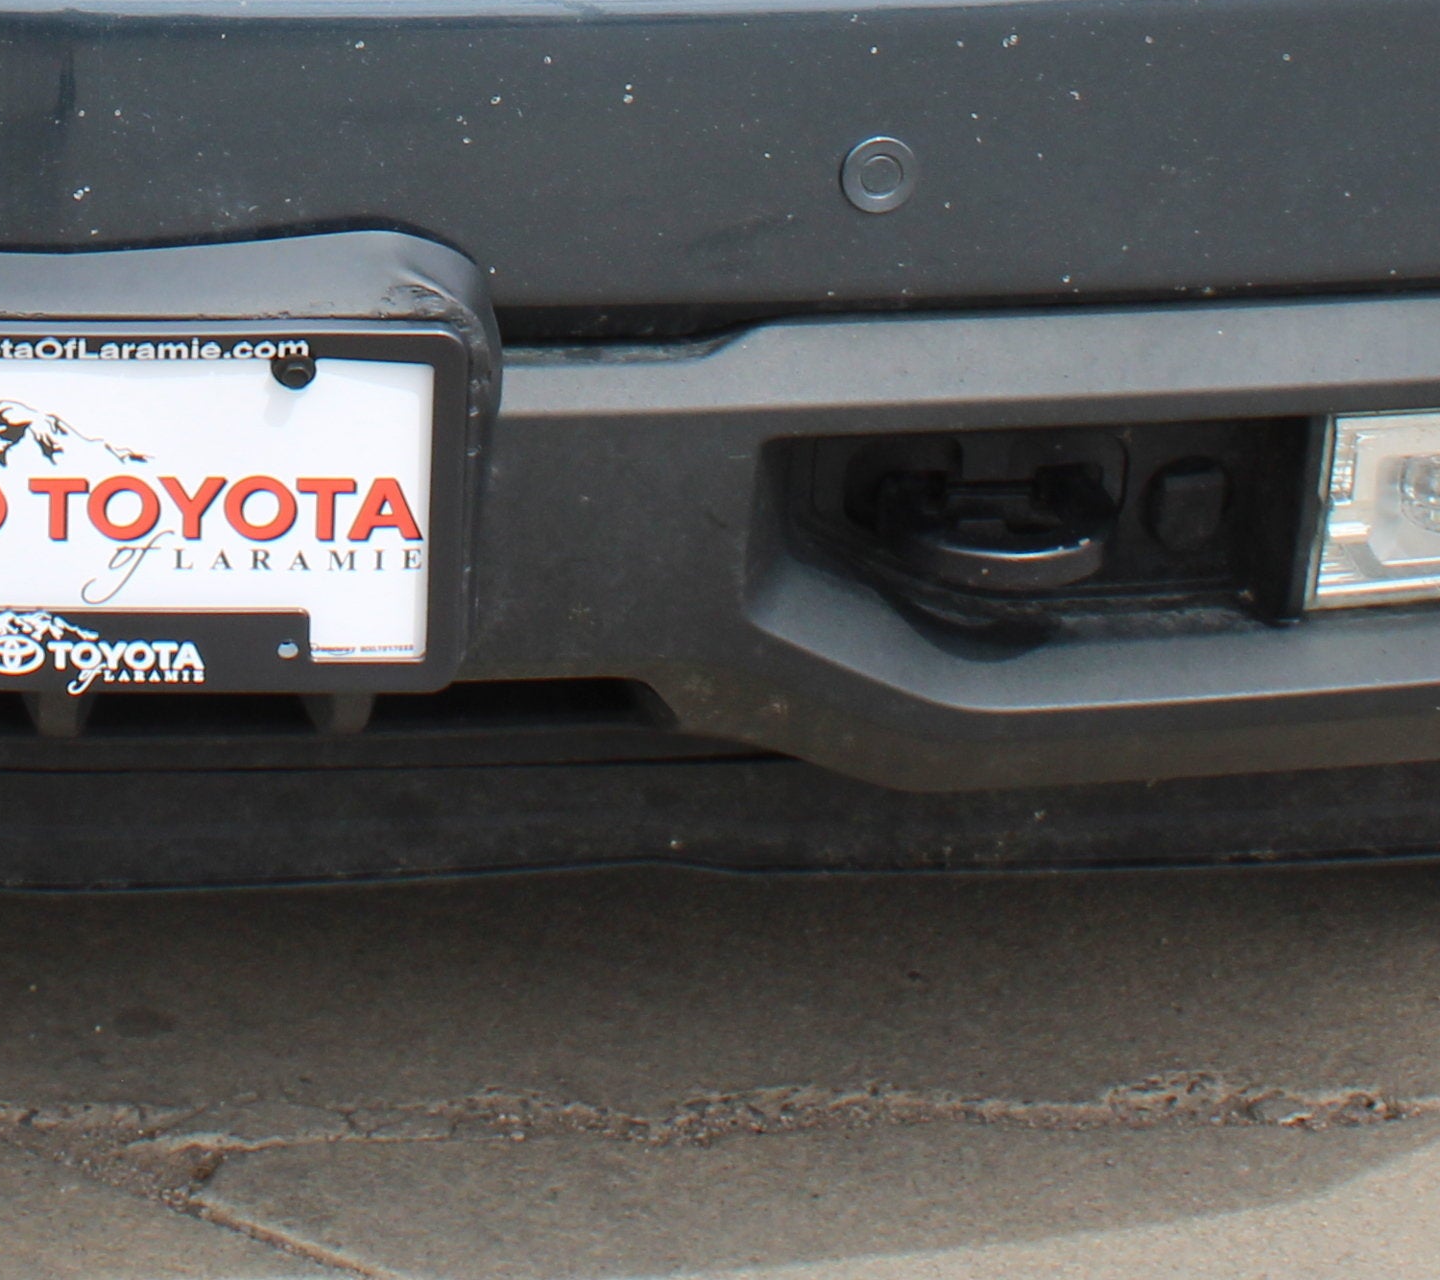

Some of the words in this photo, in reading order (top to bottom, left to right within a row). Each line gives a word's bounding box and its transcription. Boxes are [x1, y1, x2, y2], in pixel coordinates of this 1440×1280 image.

[28, 475, 424, 542] TOYOTA
[81, 530, 175, 605] of
[174, 548, 423, 572] LARAMIE
[46, 640, 205, 671] TOYOTA
[67, 662, 108, 696] of
[103, 669, 206, 683] LARAMIE
